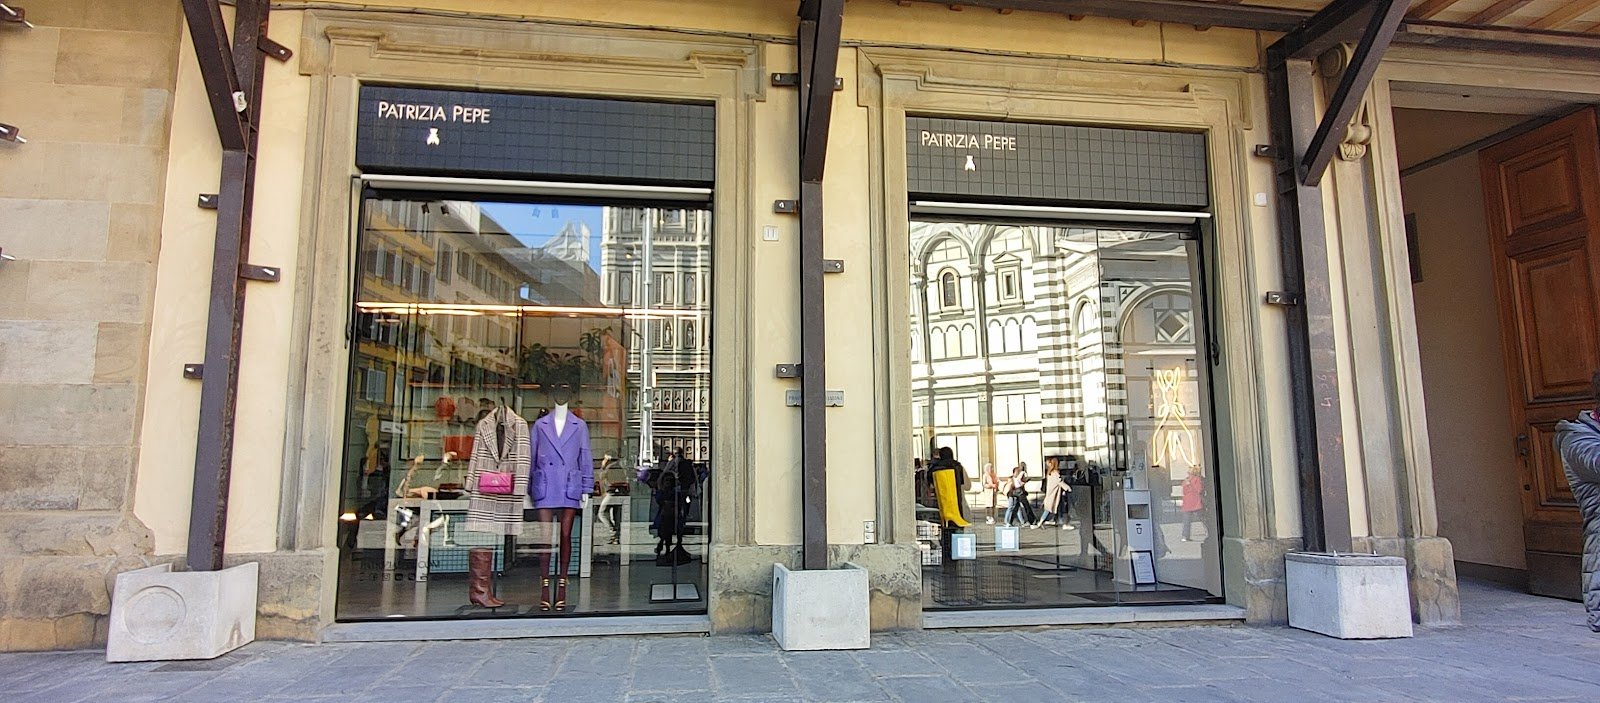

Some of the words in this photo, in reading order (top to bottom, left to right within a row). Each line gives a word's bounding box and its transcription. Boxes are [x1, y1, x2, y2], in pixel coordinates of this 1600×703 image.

[378, 101, 447, 122] PATRIZIA
[452, 105, 491, 124] PEPE
[921, 130, 980, 149] PATRIZIA
[984, 134, 1017, 151] PEPE
